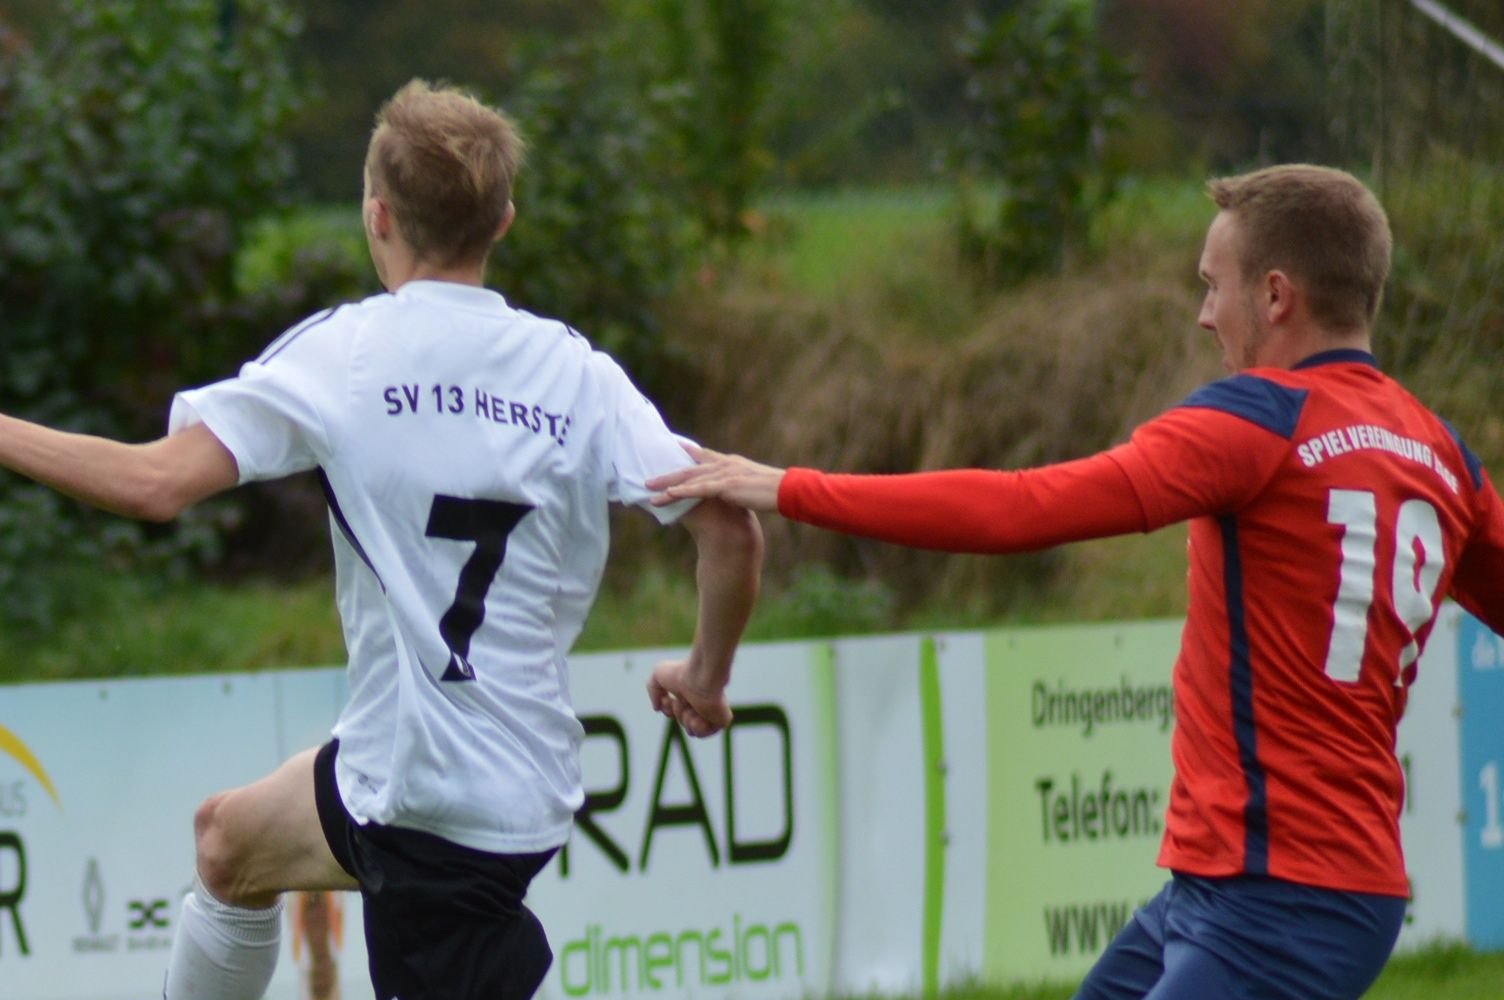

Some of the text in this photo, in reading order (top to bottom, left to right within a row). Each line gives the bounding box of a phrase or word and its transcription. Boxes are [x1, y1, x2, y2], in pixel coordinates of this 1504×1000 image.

[384, 384, 420, 415] SV
[431, 384, 466, 414] 13
[425, 493, 538, 682] 7
[1034, 768, 1161, 845] Telefon:
[560, 913, 804, 997] dimension
